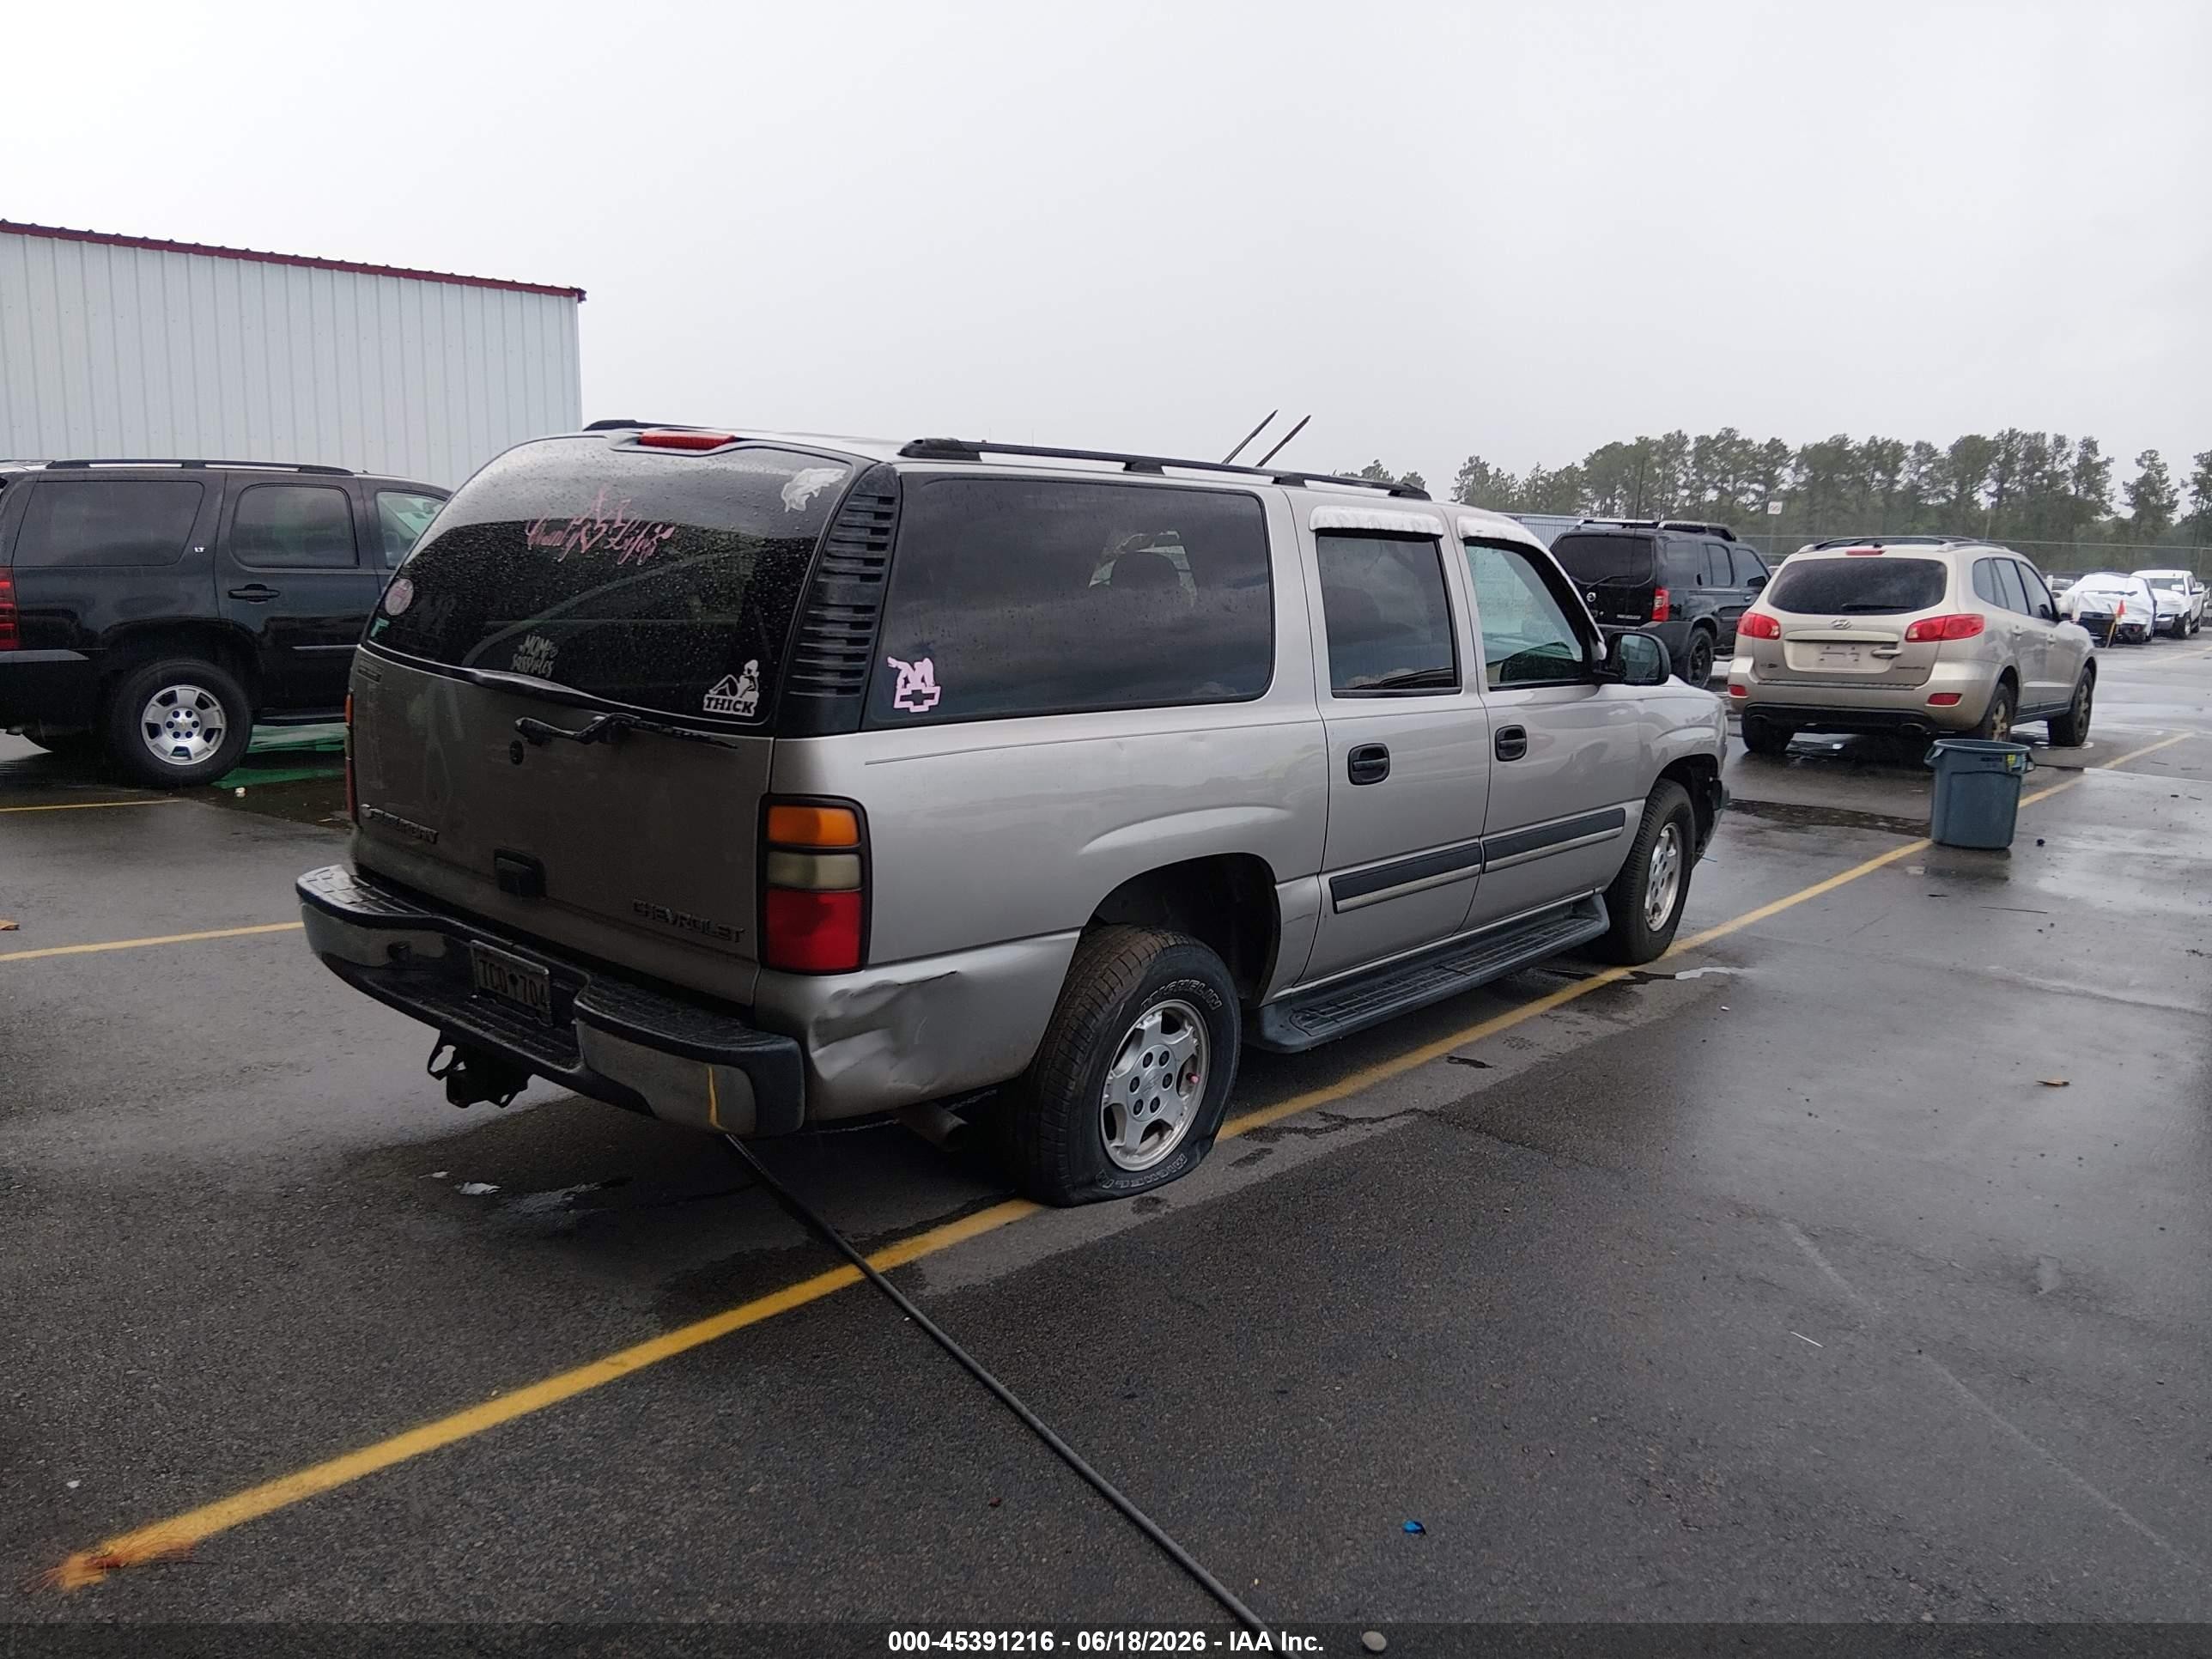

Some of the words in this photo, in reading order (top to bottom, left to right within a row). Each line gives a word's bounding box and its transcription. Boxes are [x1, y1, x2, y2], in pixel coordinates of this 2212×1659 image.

[706, 696, 755, 714] THICK
[633, 899, 745, 943] CHEVROLET
[1095, 1153, 1189, 1189] MICHELIN
